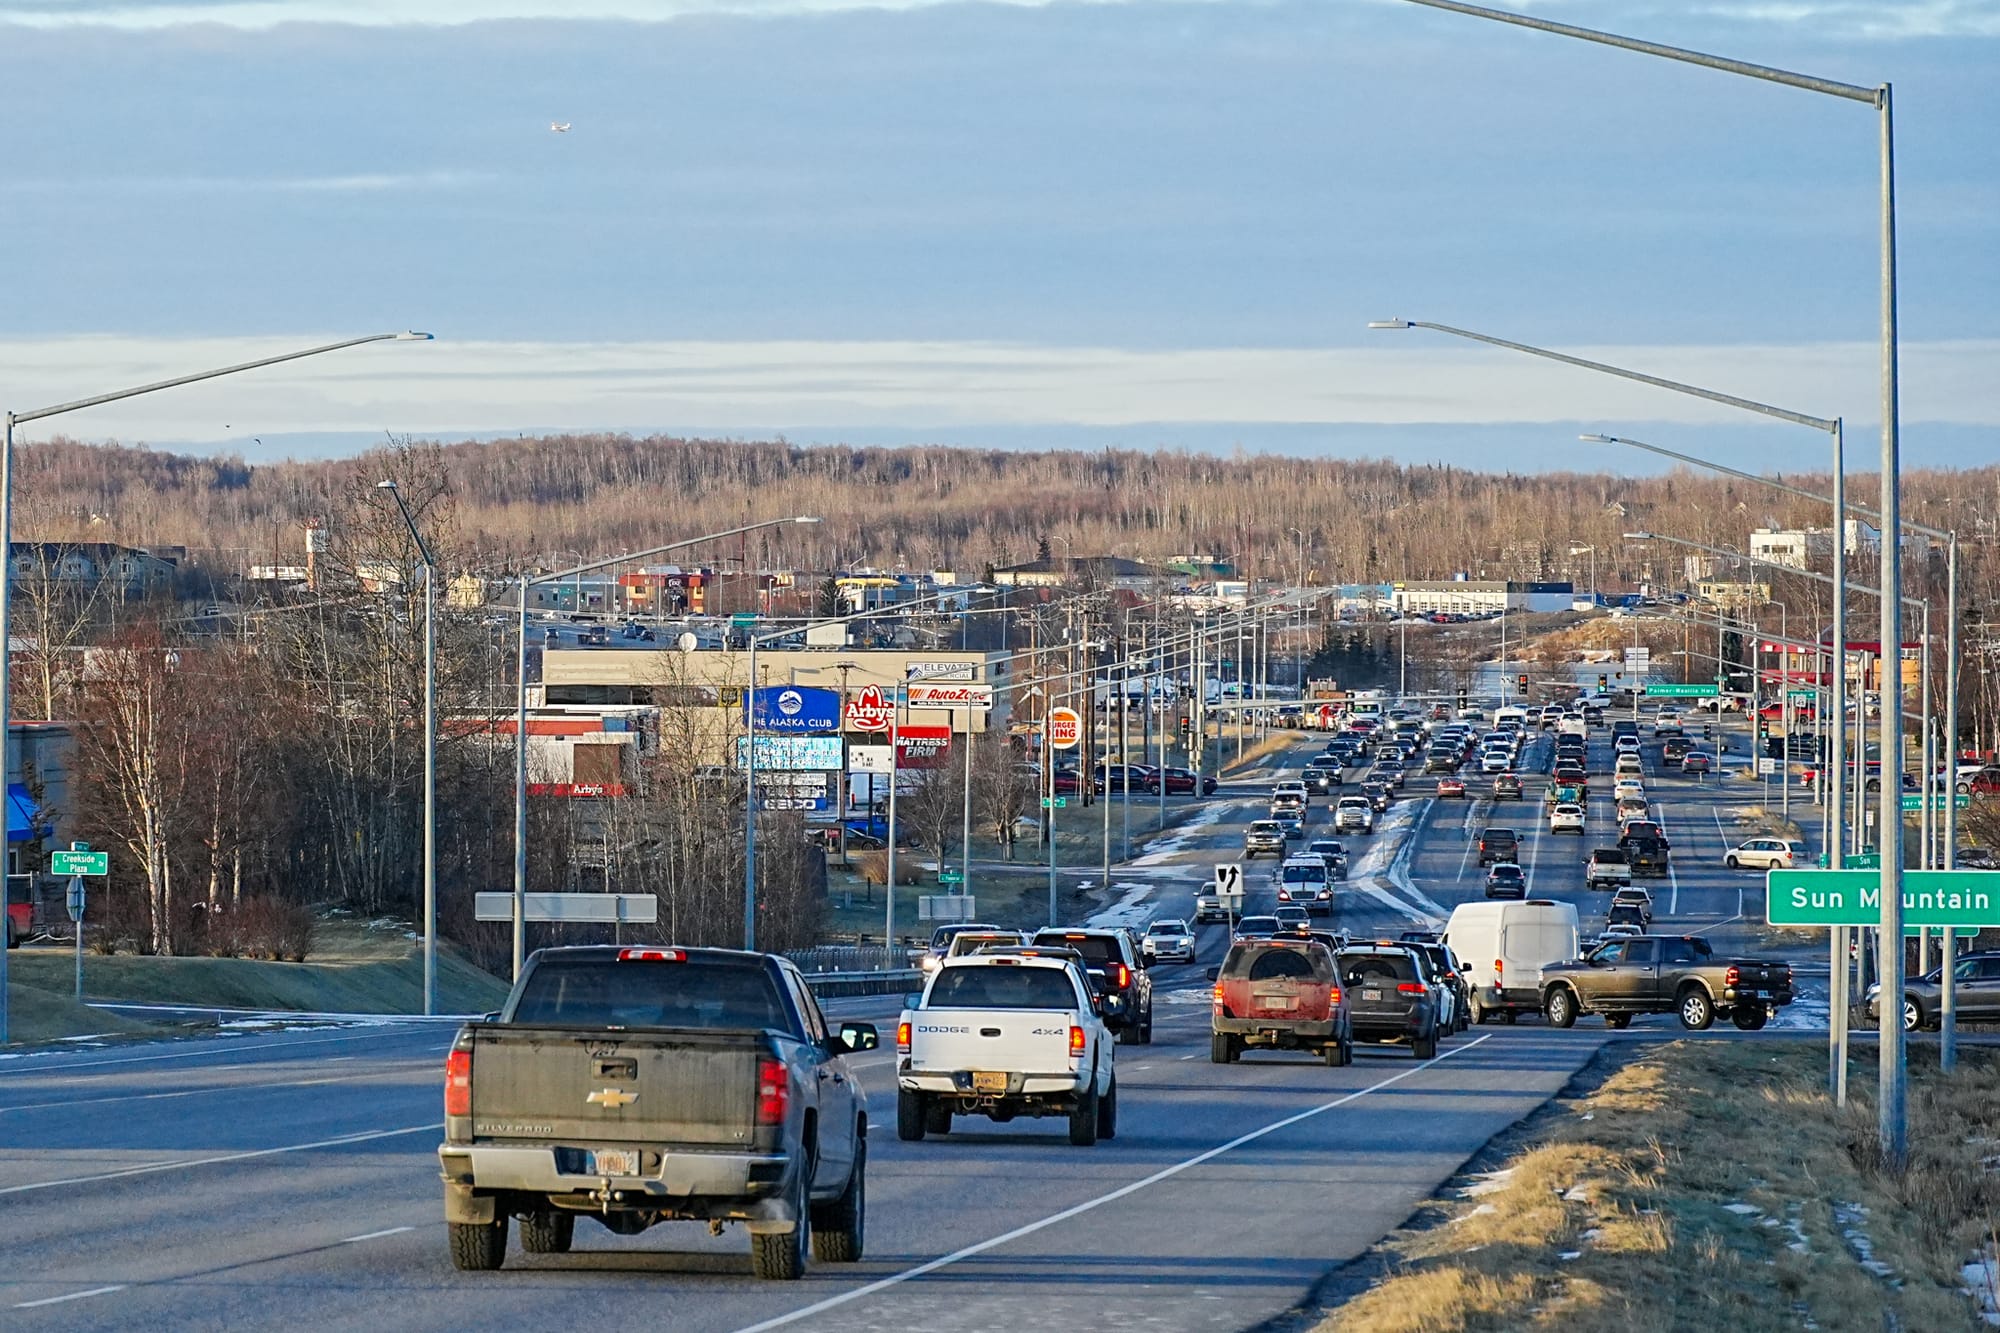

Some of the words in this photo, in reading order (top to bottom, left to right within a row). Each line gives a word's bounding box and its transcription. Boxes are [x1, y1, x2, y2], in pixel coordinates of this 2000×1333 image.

[846, 703, 894, 721] Arby's
[768, 718, 805, 727] ALASKA
[808, 718, 832, 727] CLUB
[905, 746, 937, 756] FIRM
[63, 854, 95, 863] Creekside
[70, 864, 87, 872] Plaza
[1791, 887, 1843, 908] Sun
[1859, 887, 1989, 909] Muntain
[918, 1025, 970, 1033] DODGE
